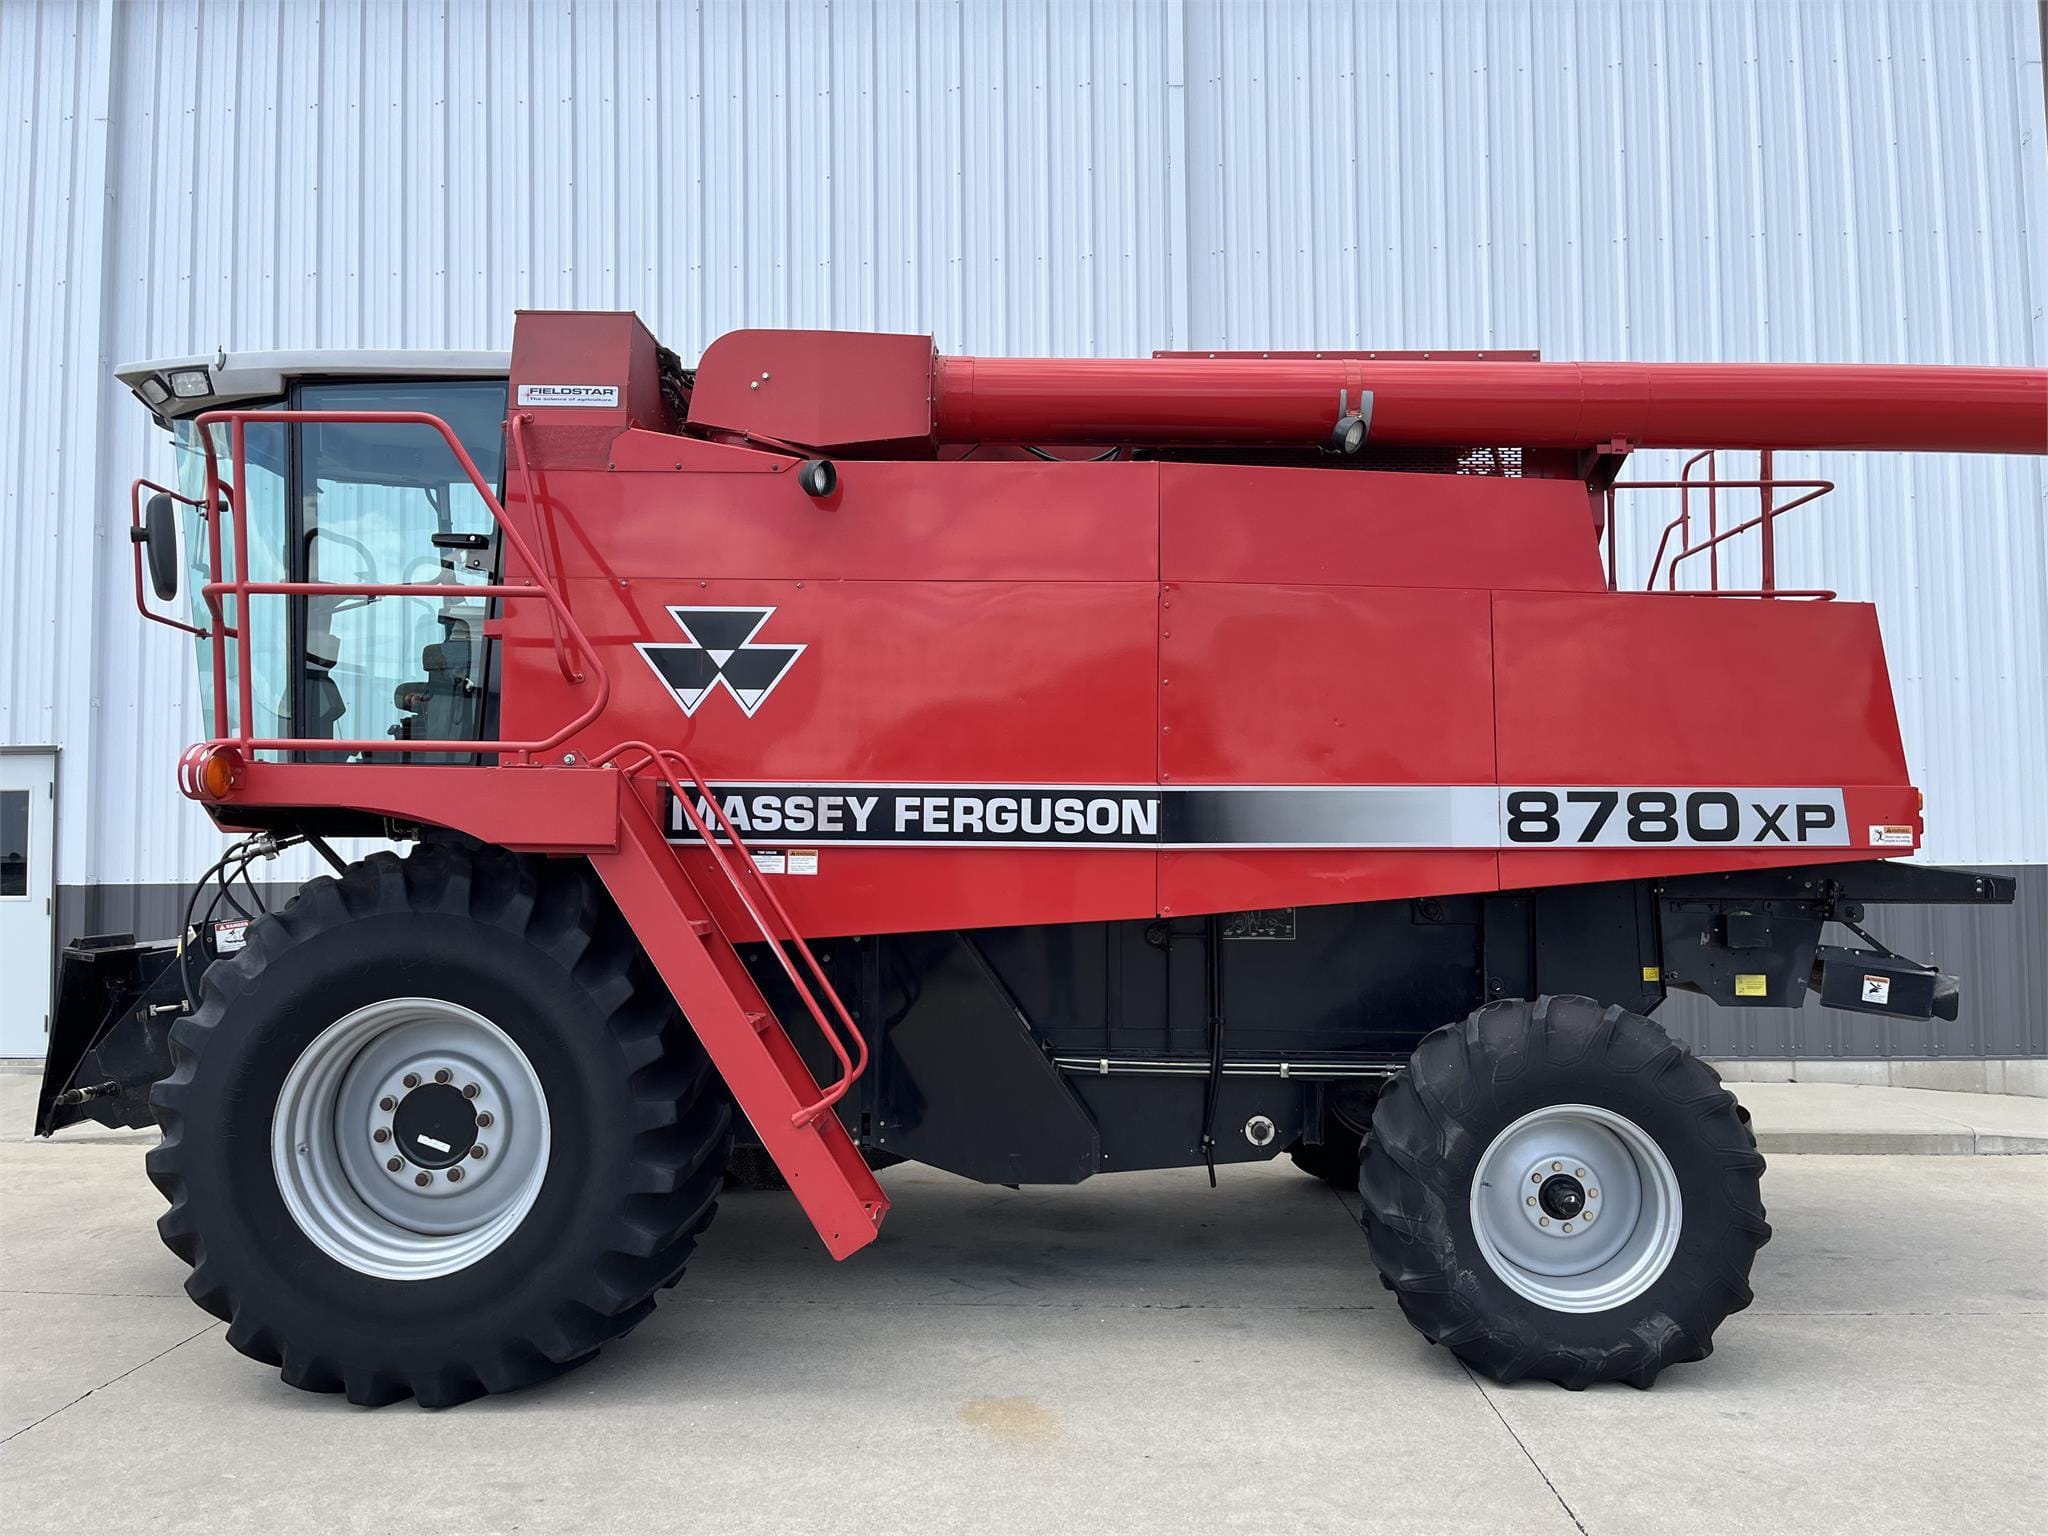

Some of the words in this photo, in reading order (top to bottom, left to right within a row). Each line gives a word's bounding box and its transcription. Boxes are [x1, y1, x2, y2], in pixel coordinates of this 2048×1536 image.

[529, 388, 613, 396] FIELDSTAR
[671, 795, 879, 833] MASSEY
[895, 797, 1158, 835] FERGUSON
[1507, 791, 1740, 843] 8780
[1753, 803, 1836, 842] XP
